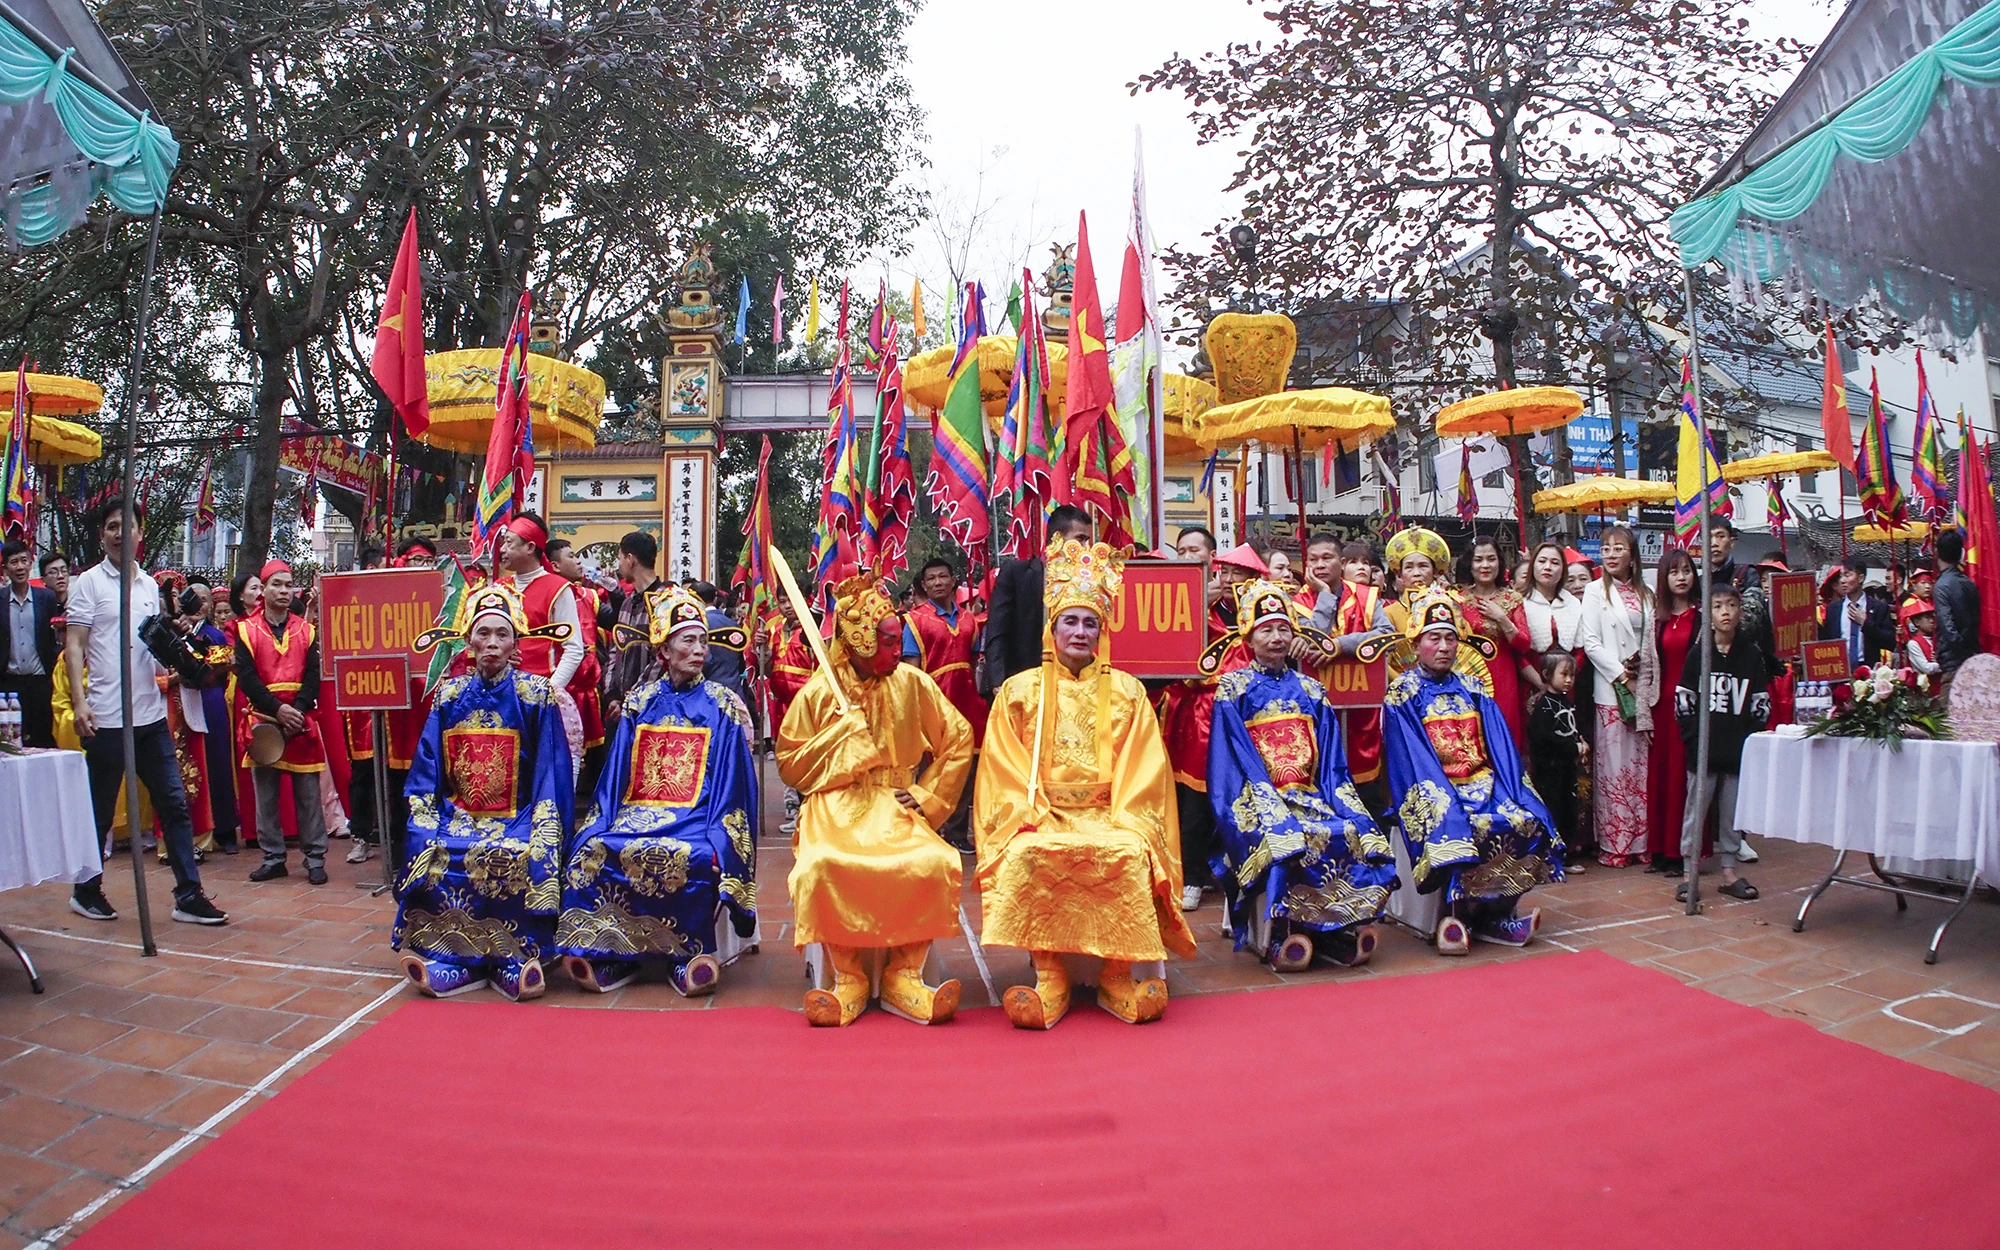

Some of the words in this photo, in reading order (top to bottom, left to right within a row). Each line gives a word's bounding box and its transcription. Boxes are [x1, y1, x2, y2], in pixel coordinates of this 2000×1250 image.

[1135, 582, 1193, 633] VUA
[1781, 582, 1811, 612] QUAN
[330, 595, 375, 656] KIỆU
[380, 591, 434, 649] CHÚA
[1813, 646, 1840, 660] QUAN
[345, 664, 397, 695] CHÚA
[1318, 664, 1369, 692] VUA
[1812, 663, 1832, 677] THỰ
